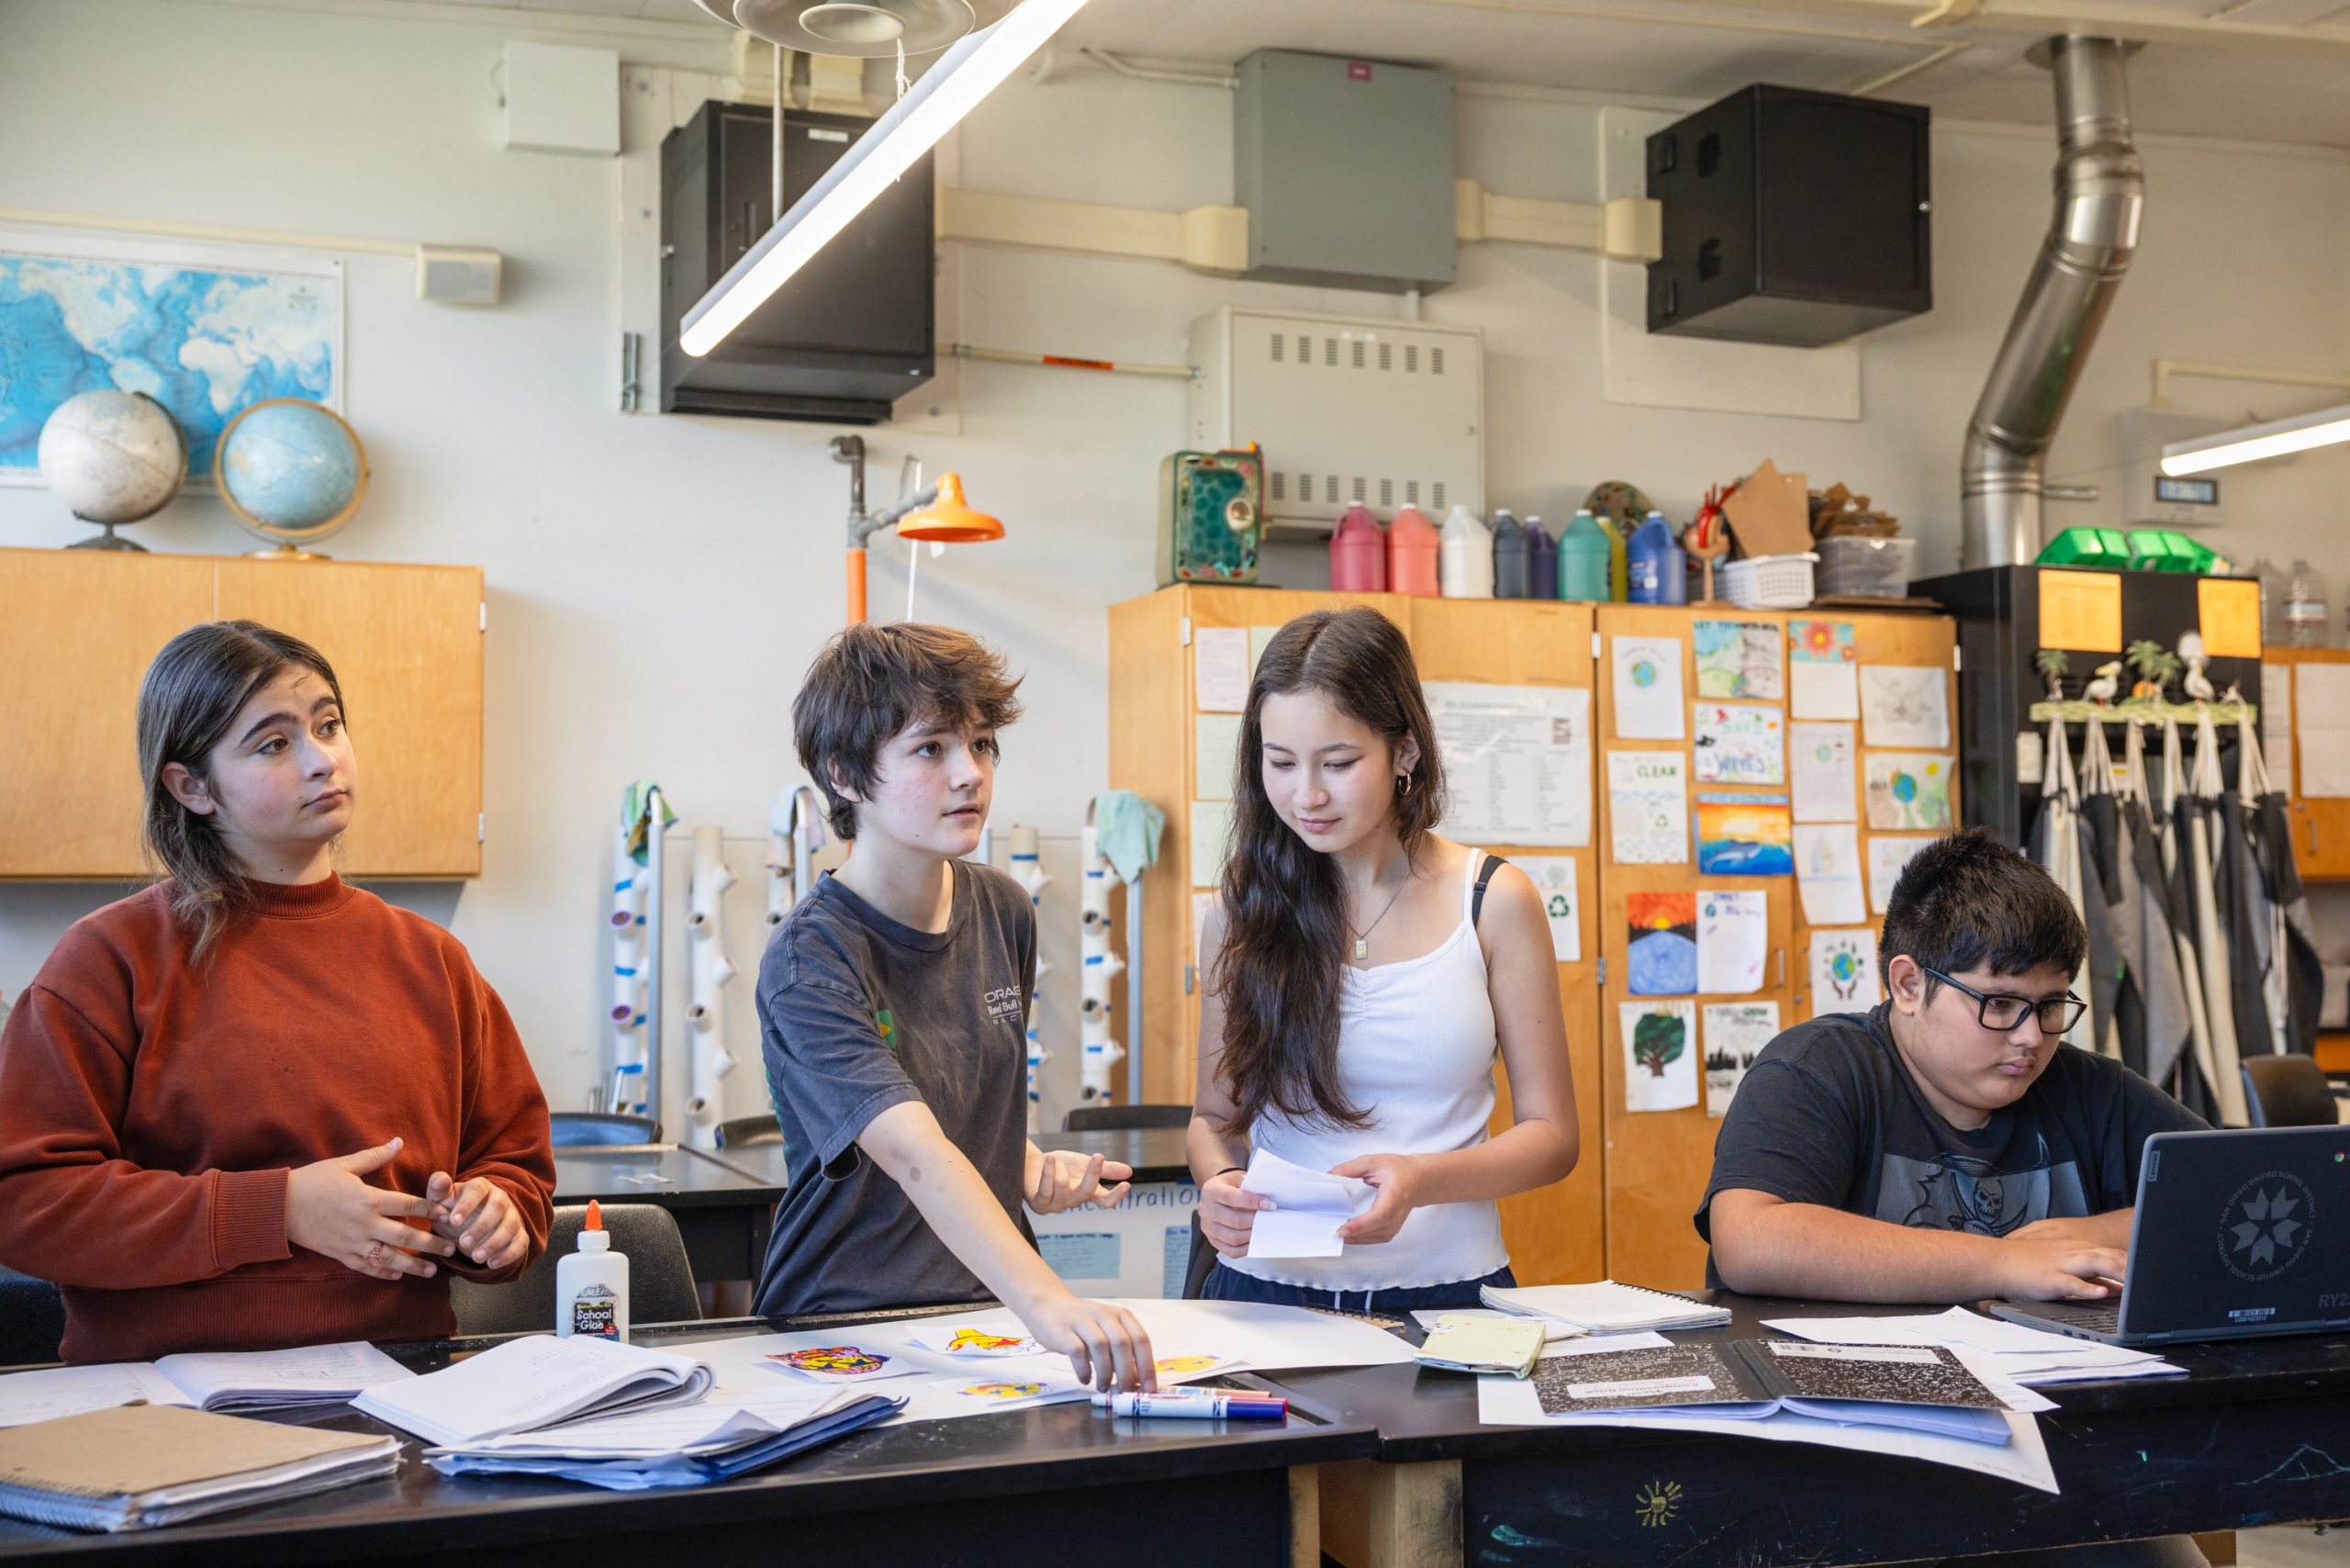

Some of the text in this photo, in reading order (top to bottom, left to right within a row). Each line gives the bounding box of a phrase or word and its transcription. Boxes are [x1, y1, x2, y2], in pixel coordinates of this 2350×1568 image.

[1637, 766, 1678, 778] CLEAN
[988, 999, 1018, 1015] Red Bull
[2149, 1153, 2158, 1181] Lenovo
[2228, 1183, 2248, 1206] DIEGO
[2248, 1170, 2277, 1186] UNIFIED
[2319, 1292, 2350, 1308] RY2
[576, 1307, 612, 1320] School
[580, 1319, 605, 1330] Glue
